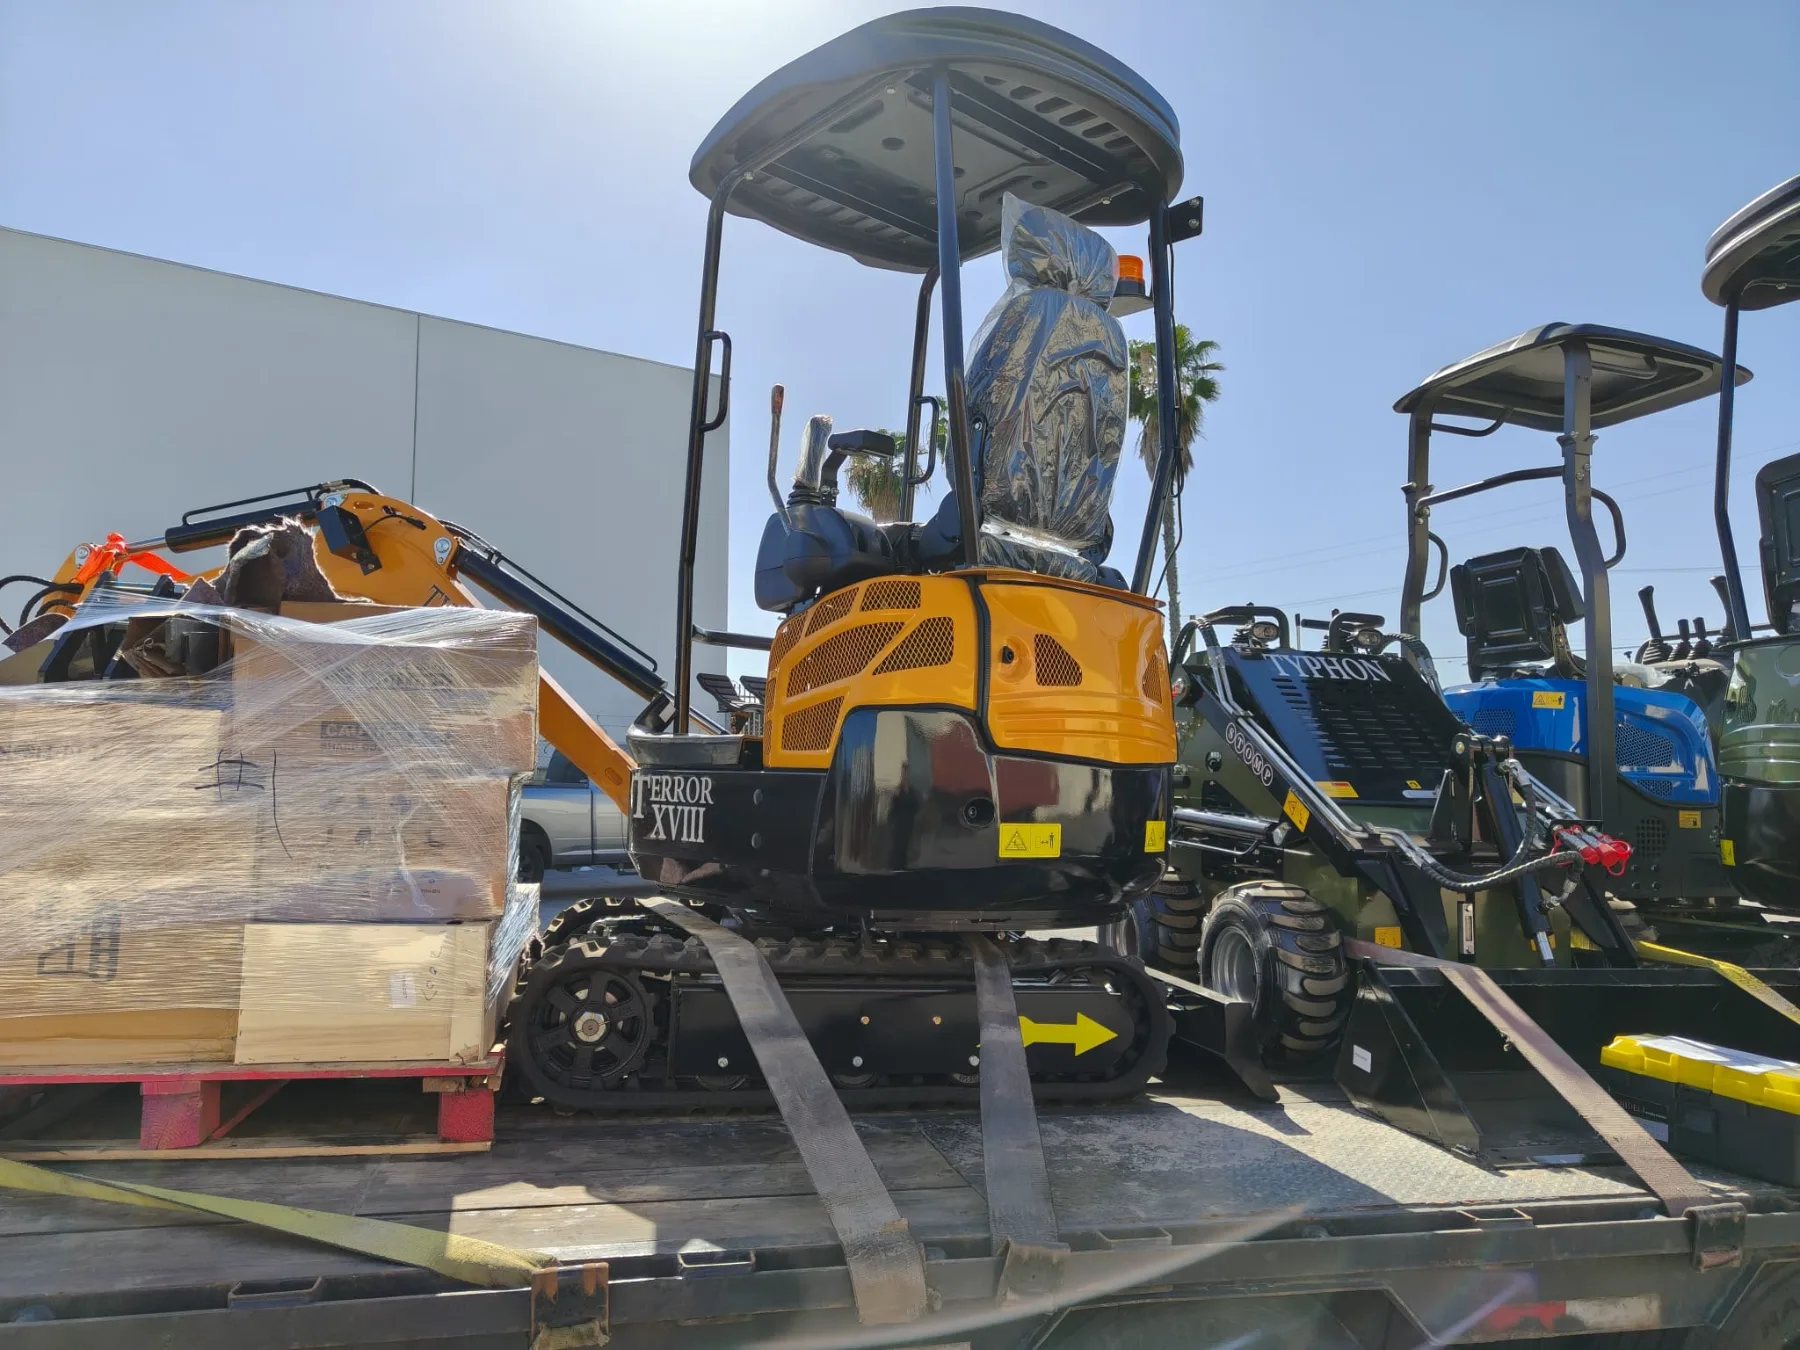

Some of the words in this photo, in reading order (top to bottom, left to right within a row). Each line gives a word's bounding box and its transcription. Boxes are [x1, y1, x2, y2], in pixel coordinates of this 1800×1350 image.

[1262, 653, 1392, 682] TYPHON
[1226, 723, 1273, 786] STOMP
[632, 774, 714, 819] TERROR
[650, 804, 706, 843] XVIII
